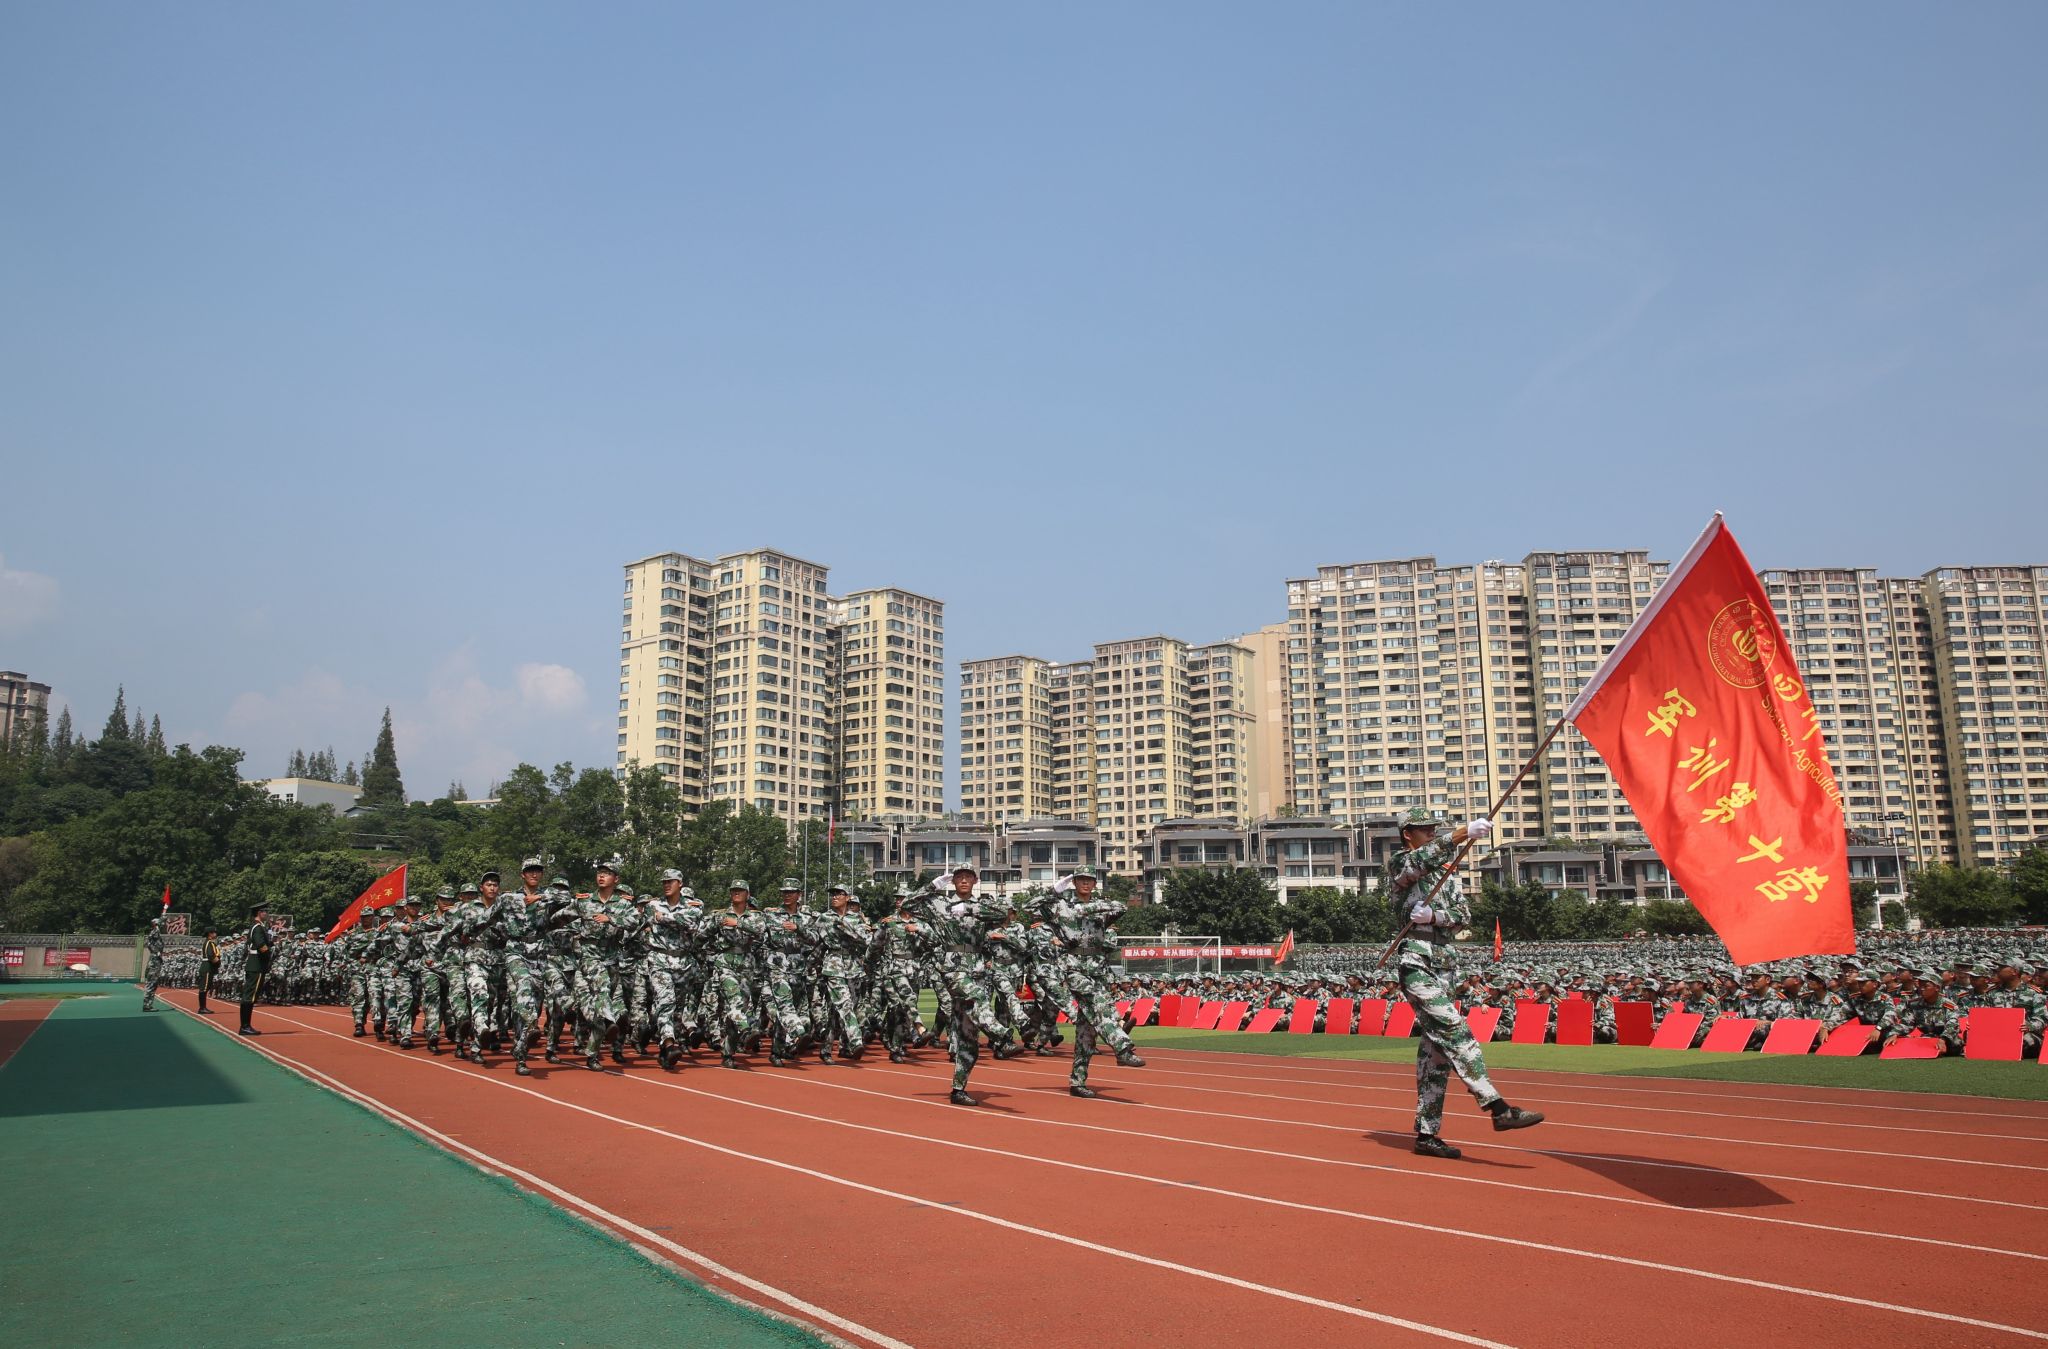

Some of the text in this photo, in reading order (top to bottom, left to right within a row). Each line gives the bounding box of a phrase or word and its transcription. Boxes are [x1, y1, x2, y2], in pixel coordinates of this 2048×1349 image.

[1645, 687, 1830, 903] 军训第十营
